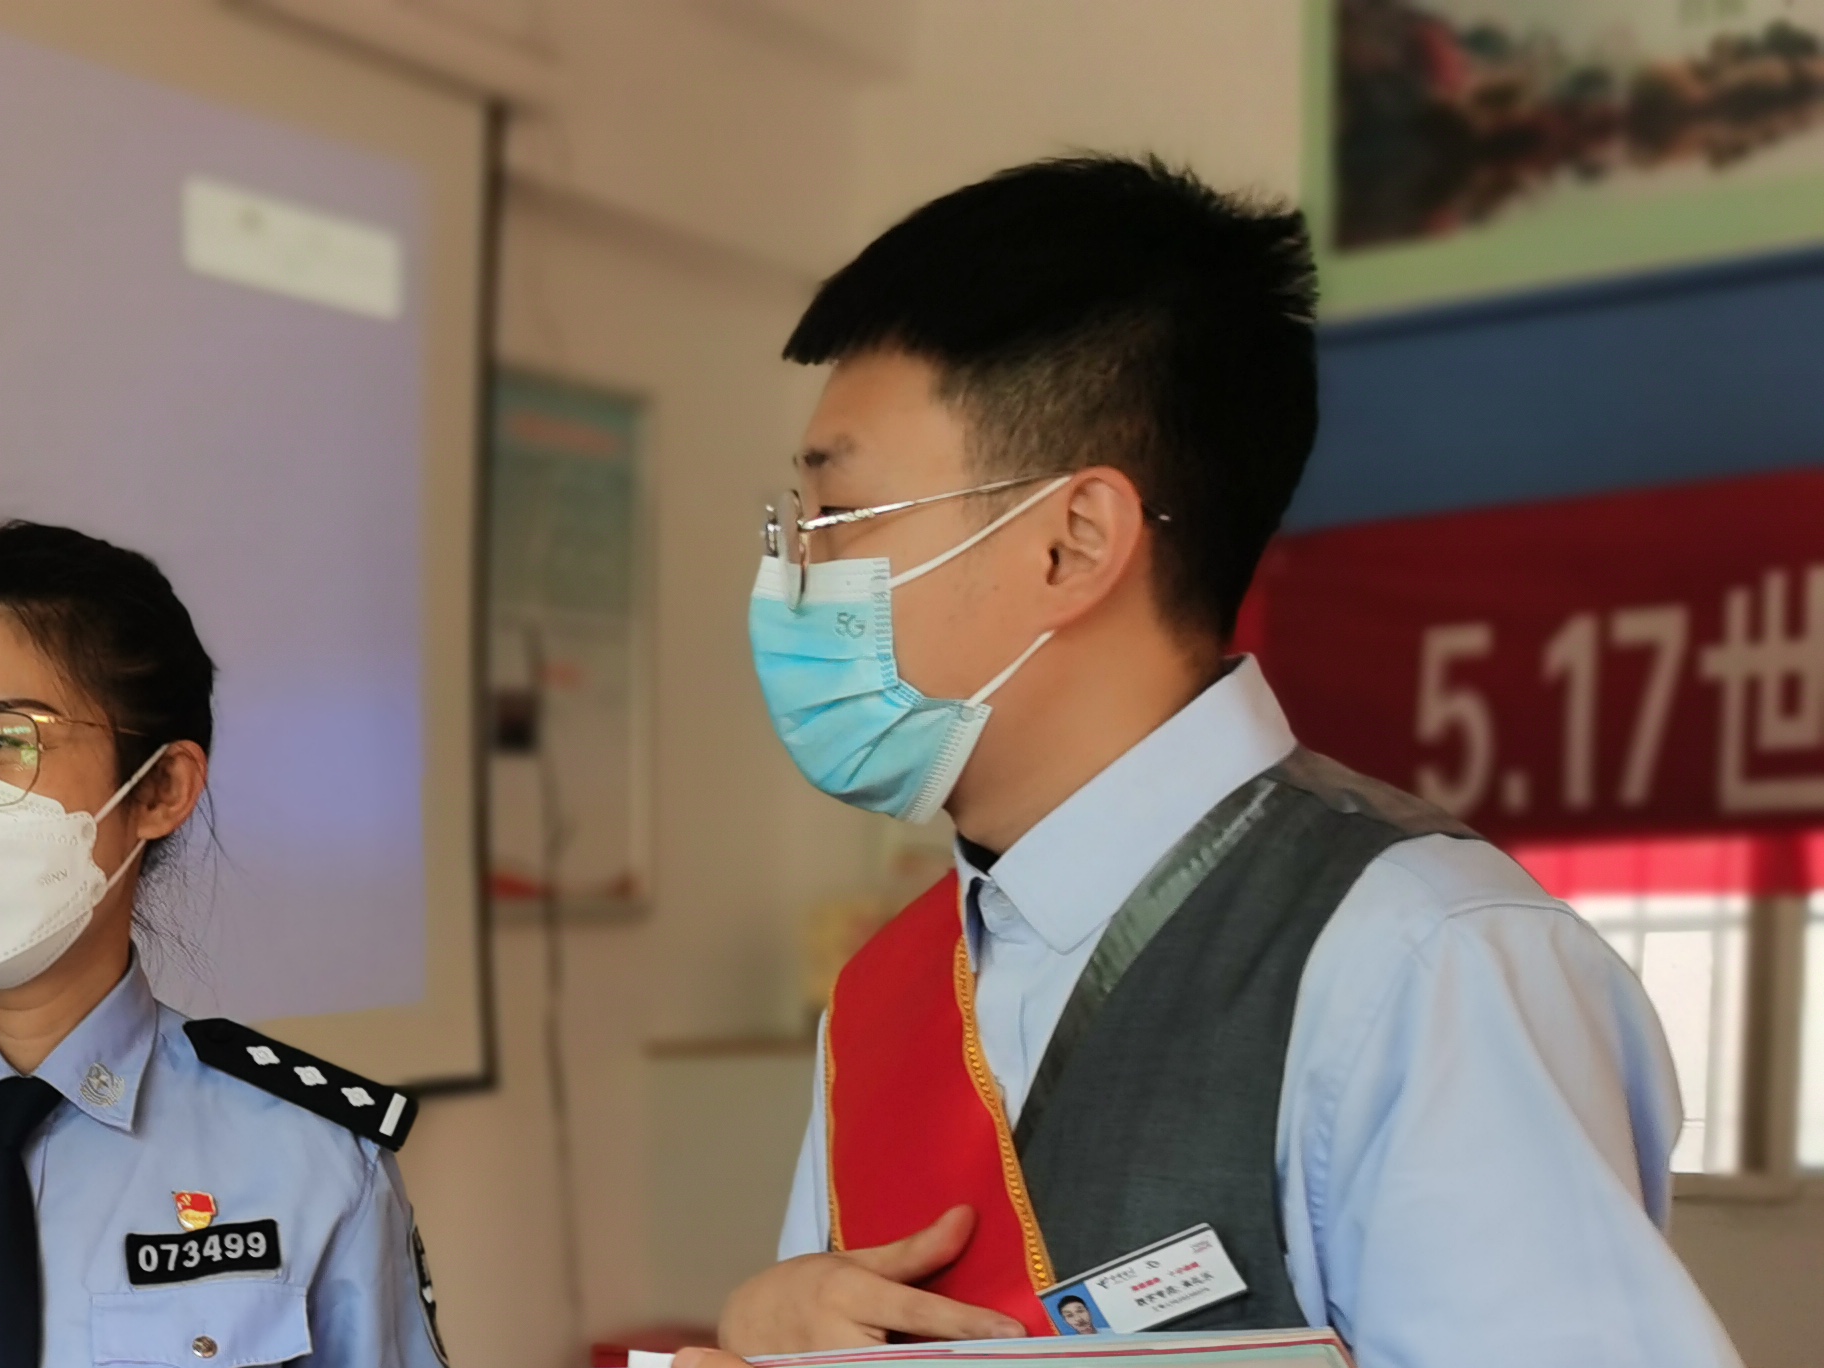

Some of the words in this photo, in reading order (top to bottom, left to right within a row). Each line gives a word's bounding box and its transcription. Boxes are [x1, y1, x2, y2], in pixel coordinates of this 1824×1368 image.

[835, 612, 866, 639] 5G
[1414, 560, 1824, 820] 5.17世
[137, 1231, 268, 1273] 073499
